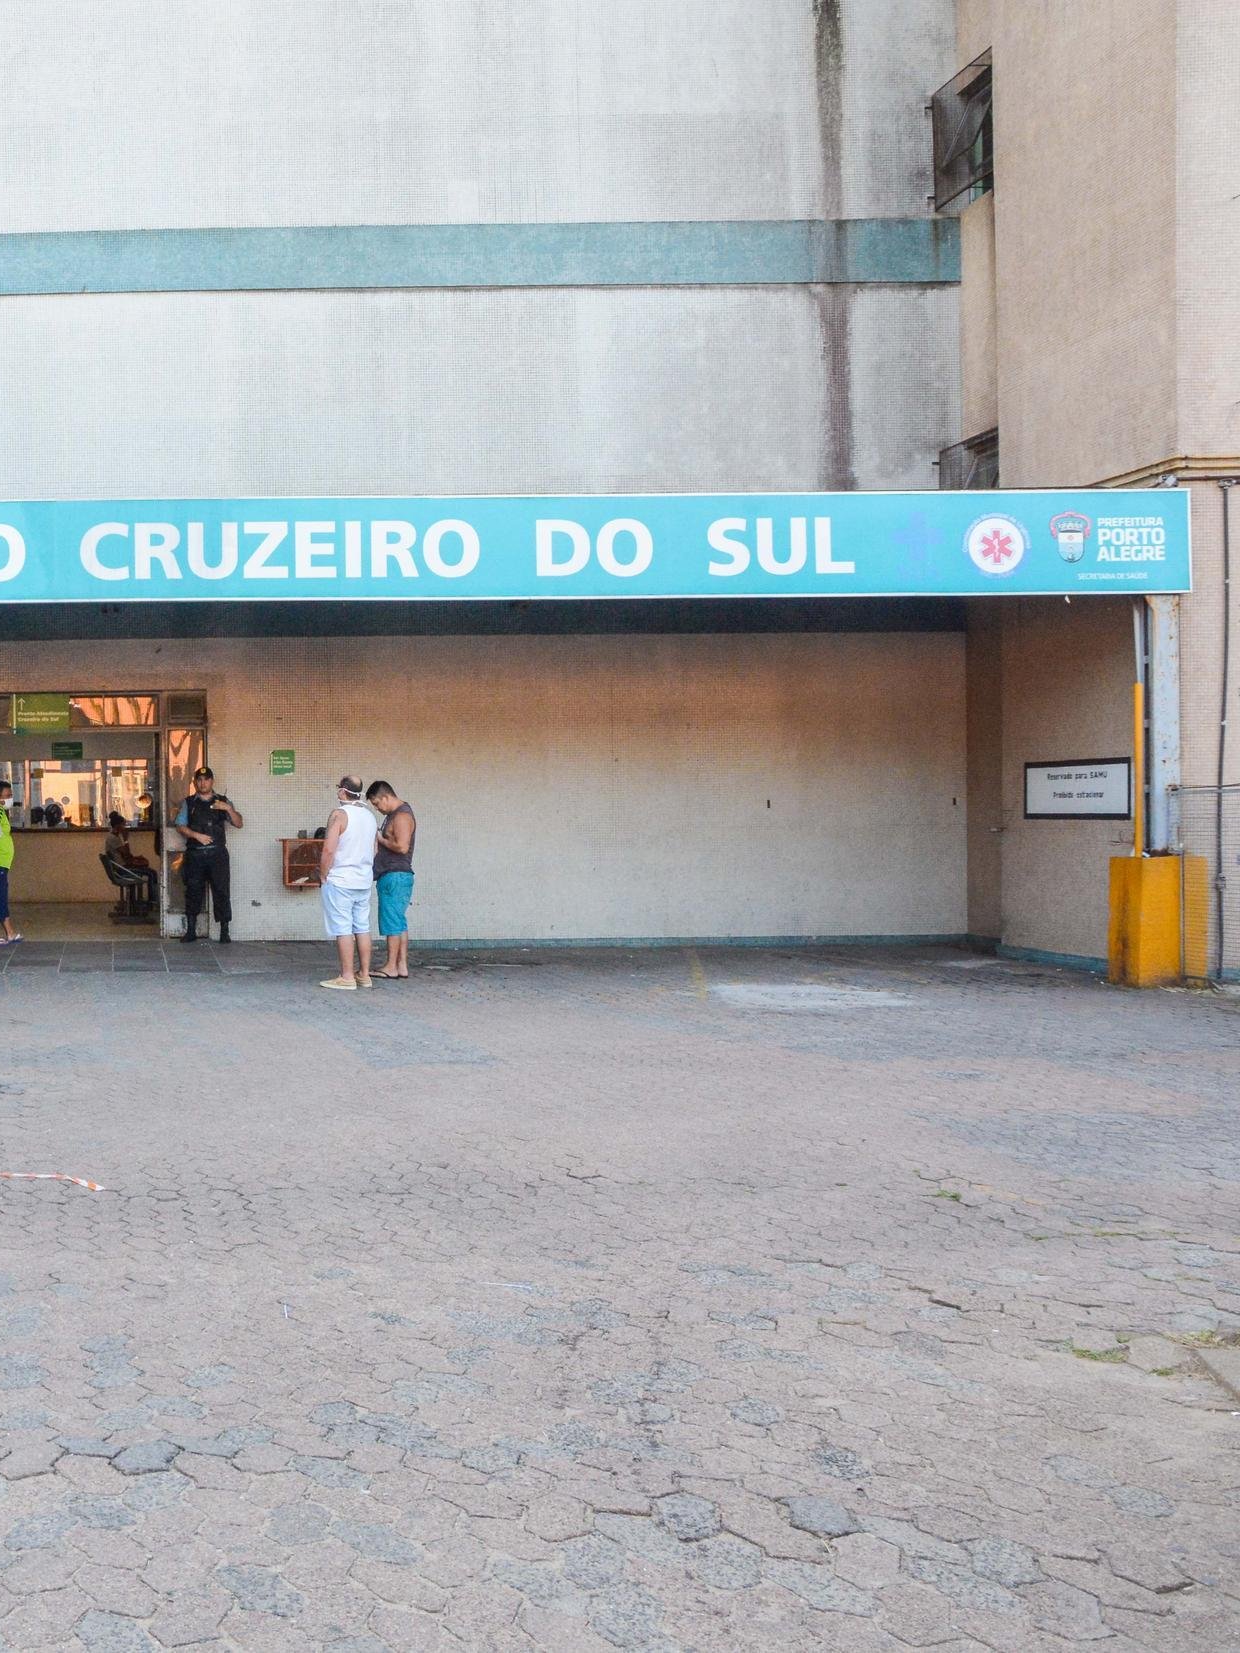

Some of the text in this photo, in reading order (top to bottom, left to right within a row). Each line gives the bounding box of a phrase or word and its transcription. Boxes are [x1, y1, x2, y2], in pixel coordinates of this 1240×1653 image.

[1097, 516, 1164, 527] PREFEITURA
[1097, 527, 1166, 546] PORTO
[79, 518, 481, 582] CRUZEIRO
[535, 518, 654, 577] DO
[706, 516, 856, 576] SUL
[1097, 545, 1166, 562] ALEGRE
[1090, 770, 1108, 779] SAMU
